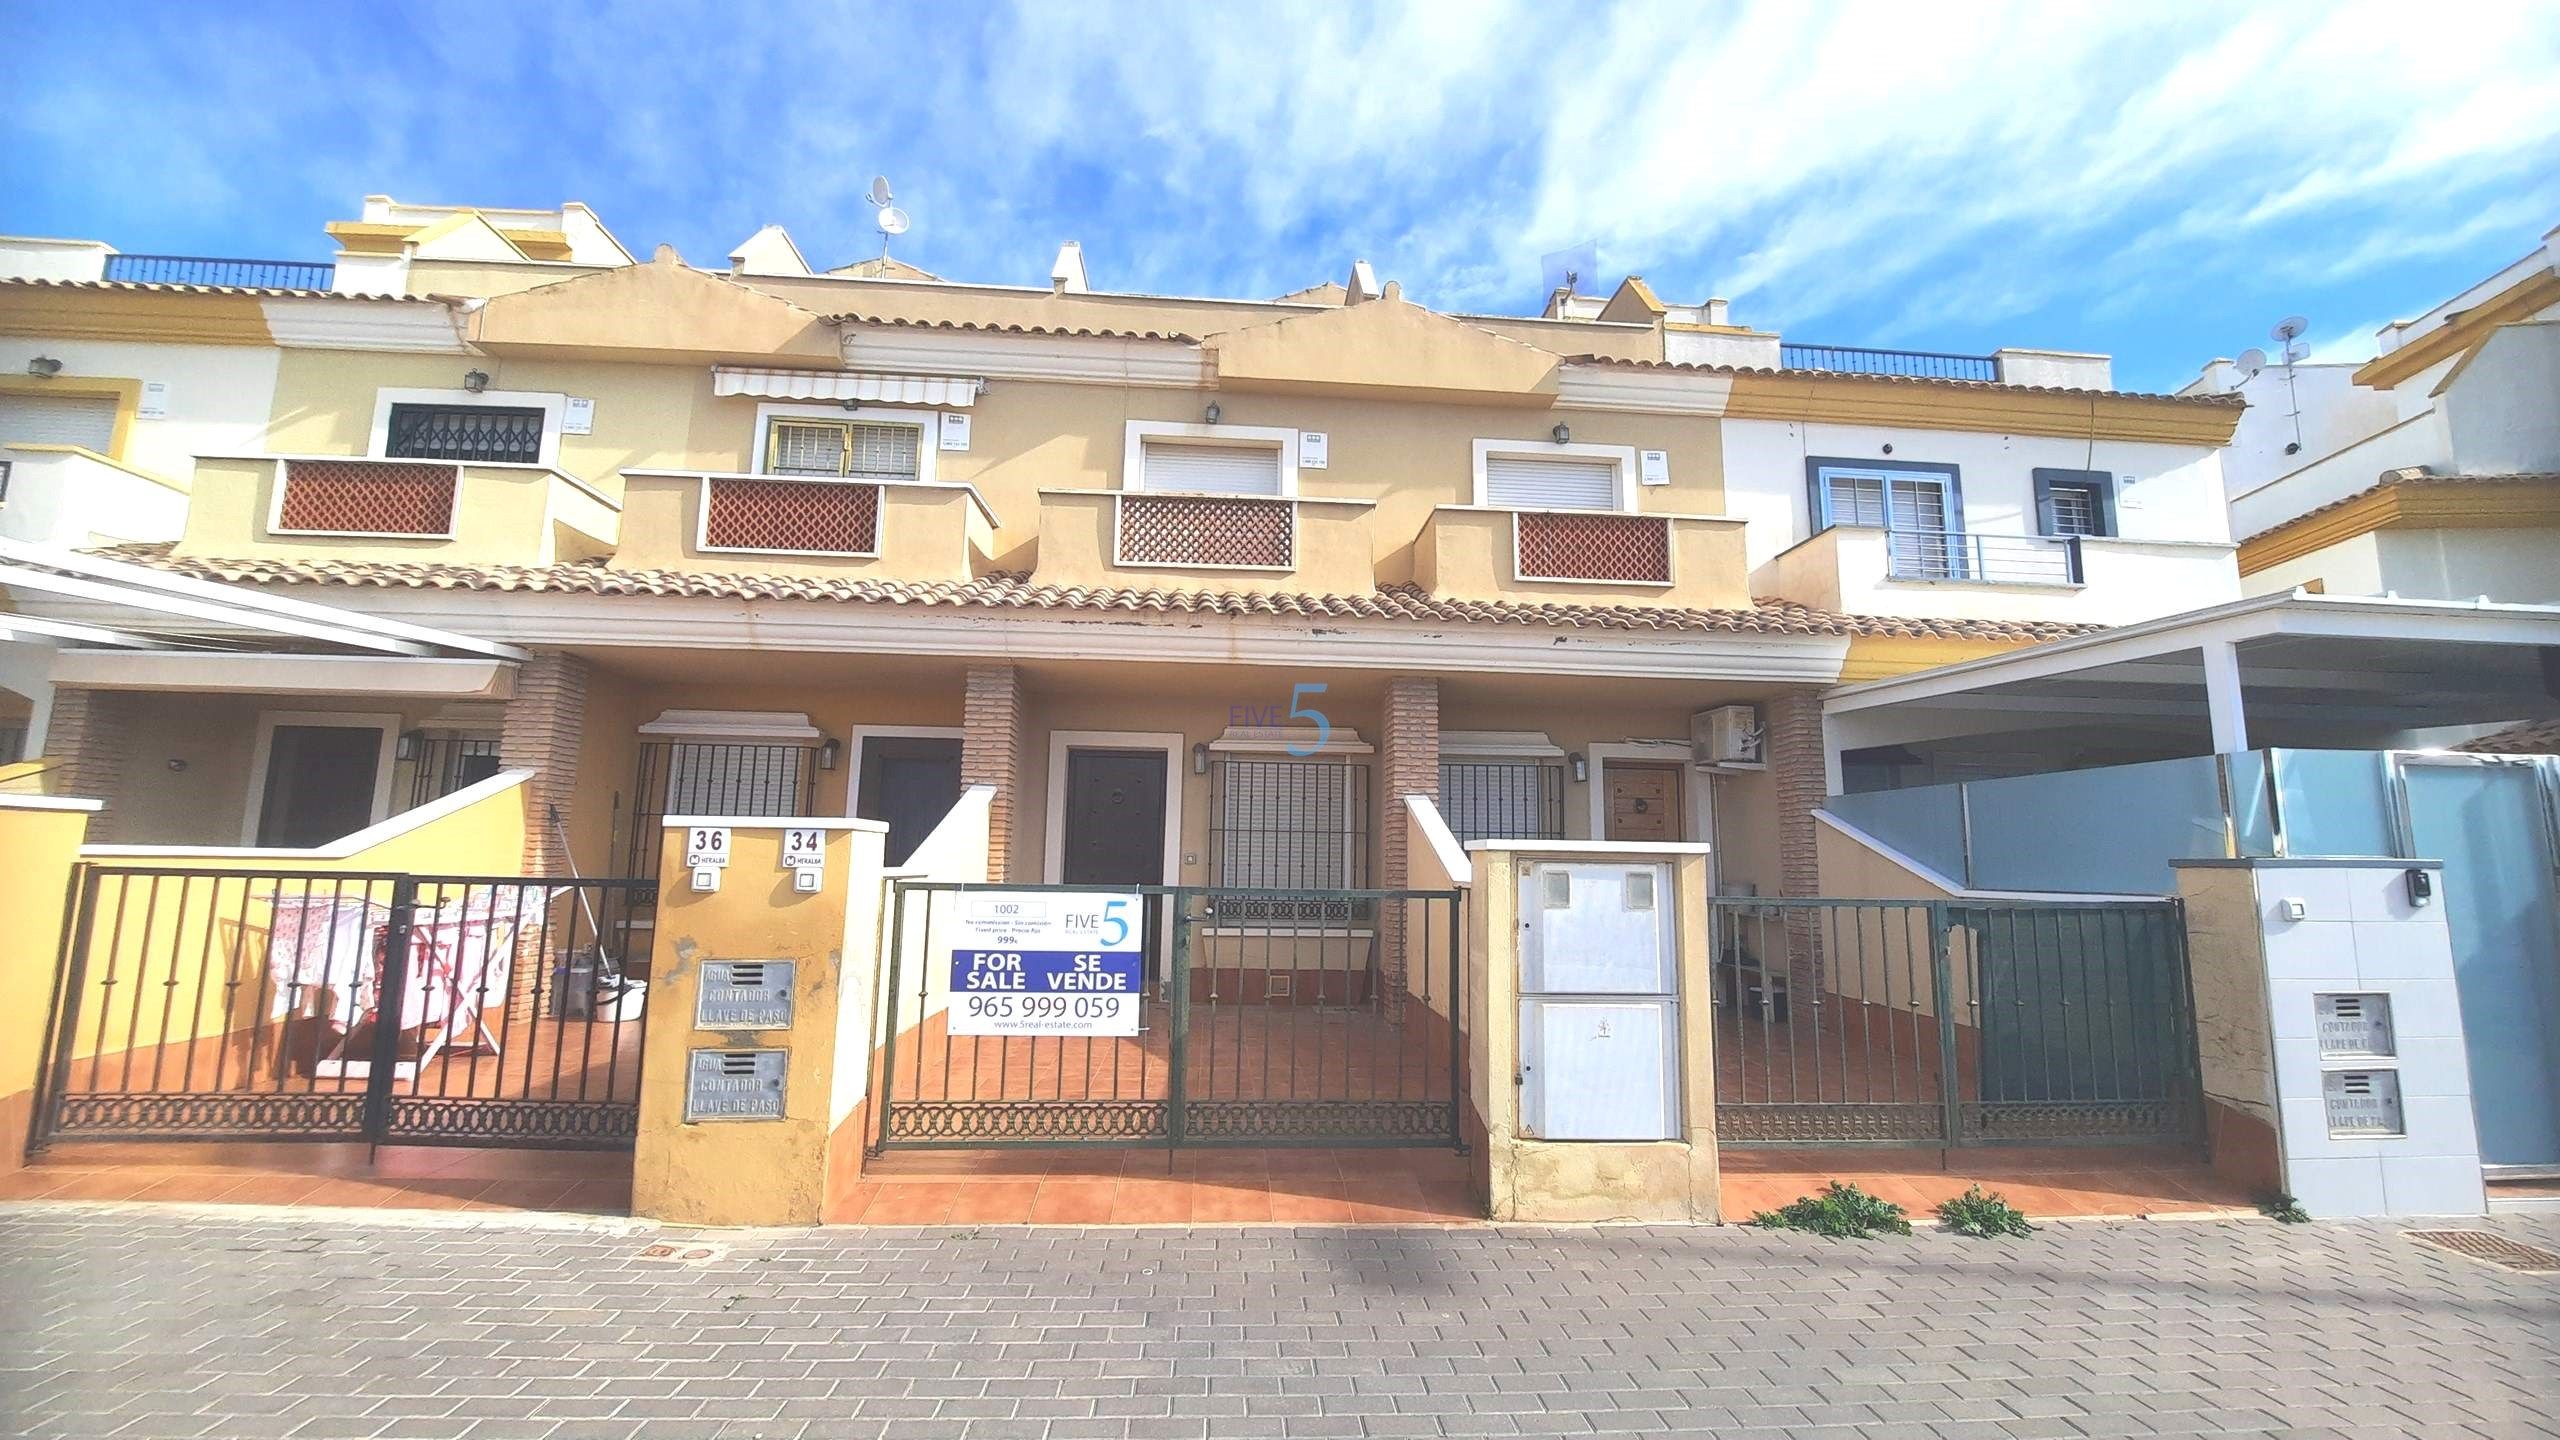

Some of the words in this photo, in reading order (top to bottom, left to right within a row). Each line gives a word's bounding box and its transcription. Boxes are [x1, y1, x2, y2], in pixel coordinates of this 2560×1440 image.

[695, 830, 723, 851] 36
[791, 831, 818, 851] 34
[994, 904, 1019, 914] 1002
[1065, 914, 1100, 929] FIVE
[1100, 901, 1129, 946] 5
[973, 953, 1022, 971] FOR
[1074, 954, 1102, 972] SE
[966, 971, 1026, 990] SALE
[1047, 972, 1127, 991] VENDE
[709, 989, 769, 1002] CONTADOR
[700, 1008, 737, 1023] LLAVE
[740, 1009, 755, 1023] DE
[968, 996, 1013, 1018] 965
[1022, 996, 1067, 1018] 999
[1075, 997, 1120, 1019] 059
[994, 1020, 1093, 1030] www.5real-estate.com
[701, 1079, 763, 1092] CONTADOR
[693, 1099, 728, 1113] LLAVE
[732, 1099, 747, 1113] DE
